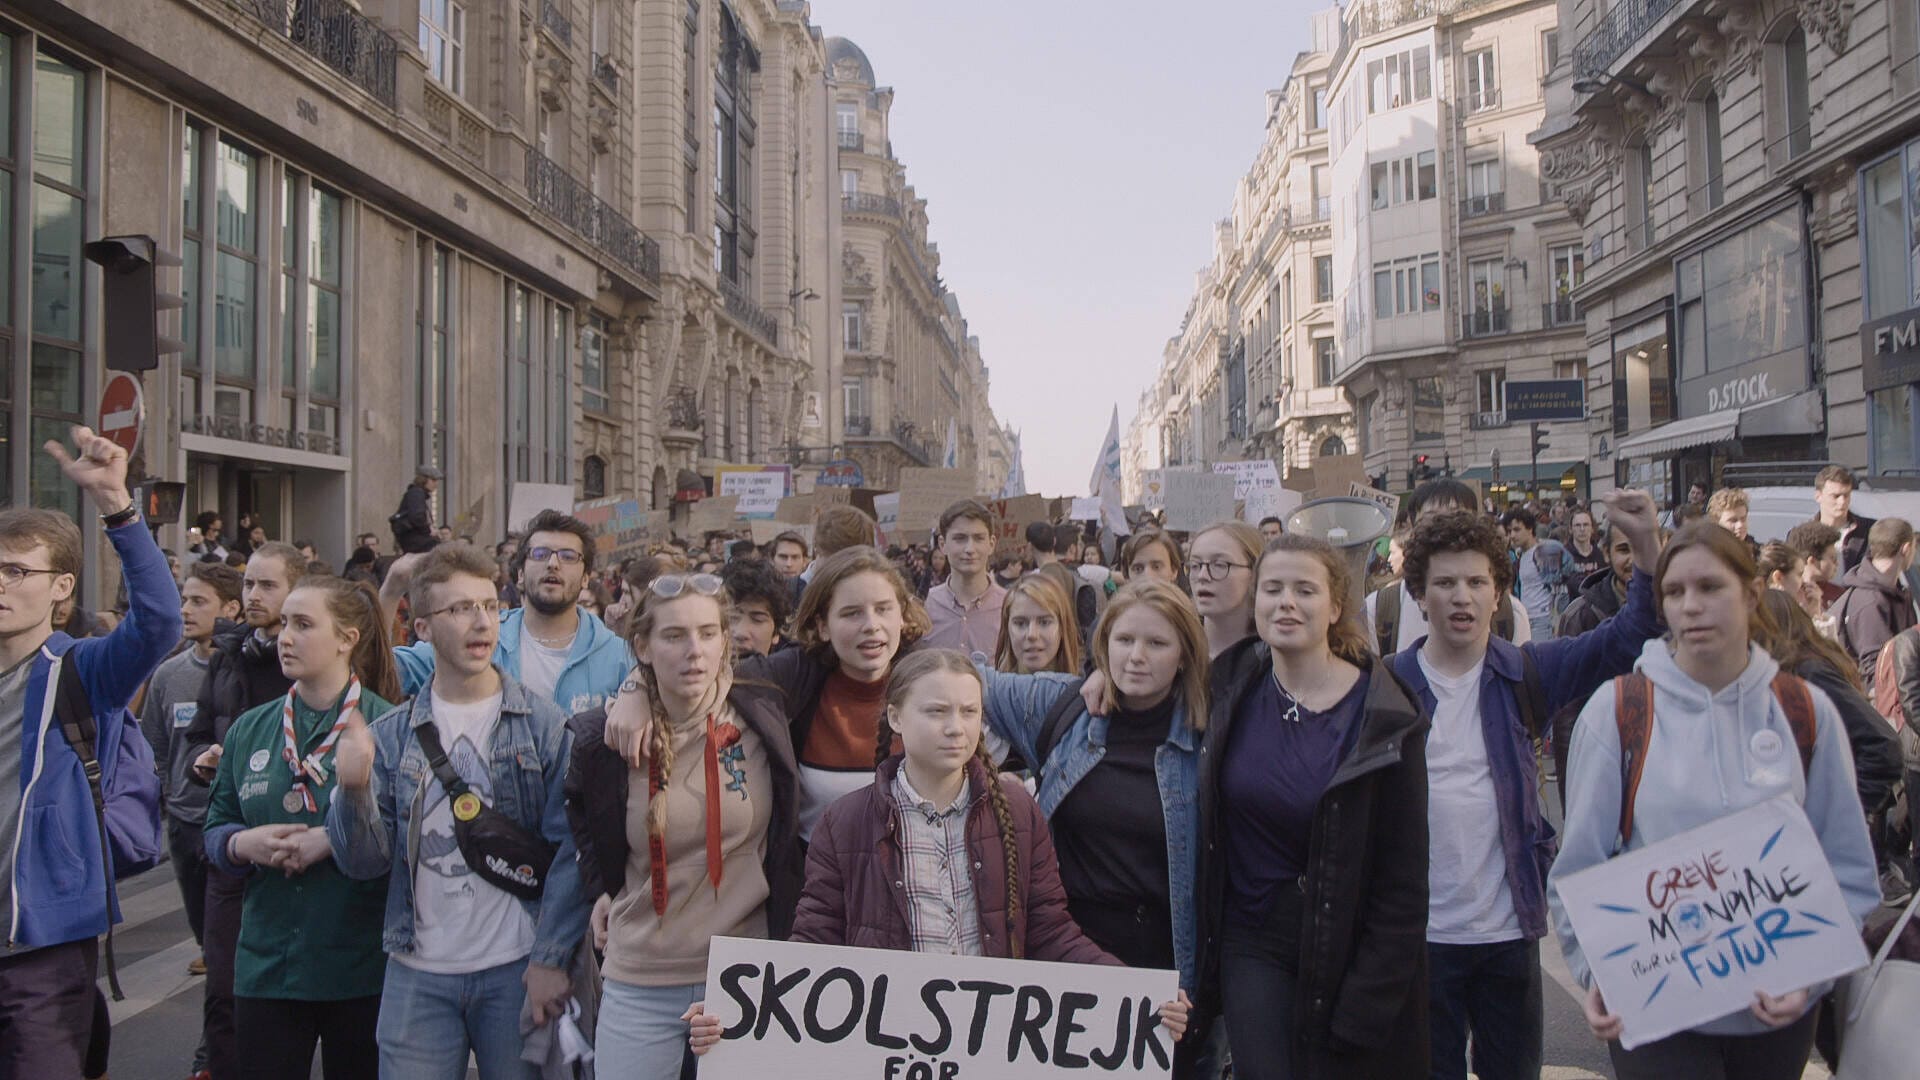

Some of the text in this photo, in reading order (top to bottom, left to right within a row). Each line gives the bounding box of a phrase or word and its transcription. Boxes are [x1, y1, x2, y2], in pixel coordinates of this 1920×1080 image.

[1874, 318, 1920, 356] FM
[1532, 391, 1567, 400] MAISON
[1708, 371, 1769, 413] D.STOCK
[719, 961, 1171, 1071] SKOLSTREJK
[884, 1053, 960, 1080] FÖR
